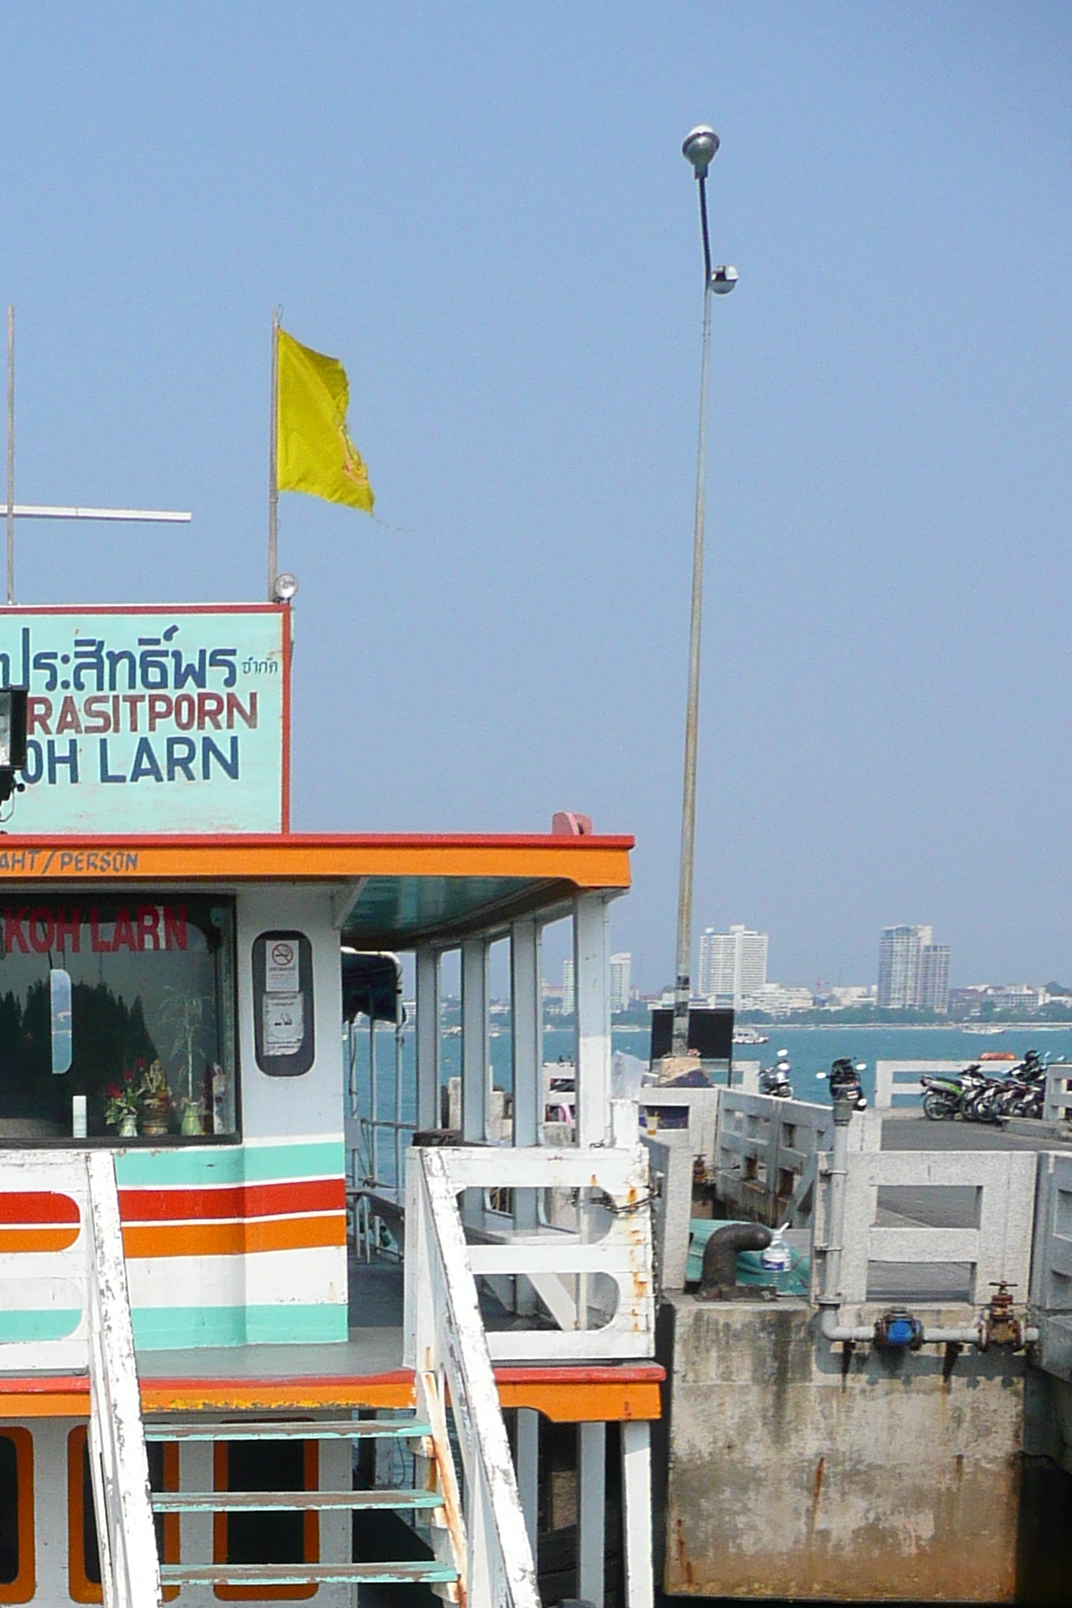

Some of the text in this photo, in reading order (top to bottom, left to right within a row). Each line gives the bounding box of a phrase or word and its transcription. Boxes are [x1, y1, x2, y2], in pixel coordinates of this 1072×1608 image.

[27, 691, 258, 735] RASITPORN
[22, 738, 79, 784] OH
[100, 735, 240, 784] LARN
[3, 905, 80, 954] KOH
[90, 904, 189, 953] LARN
